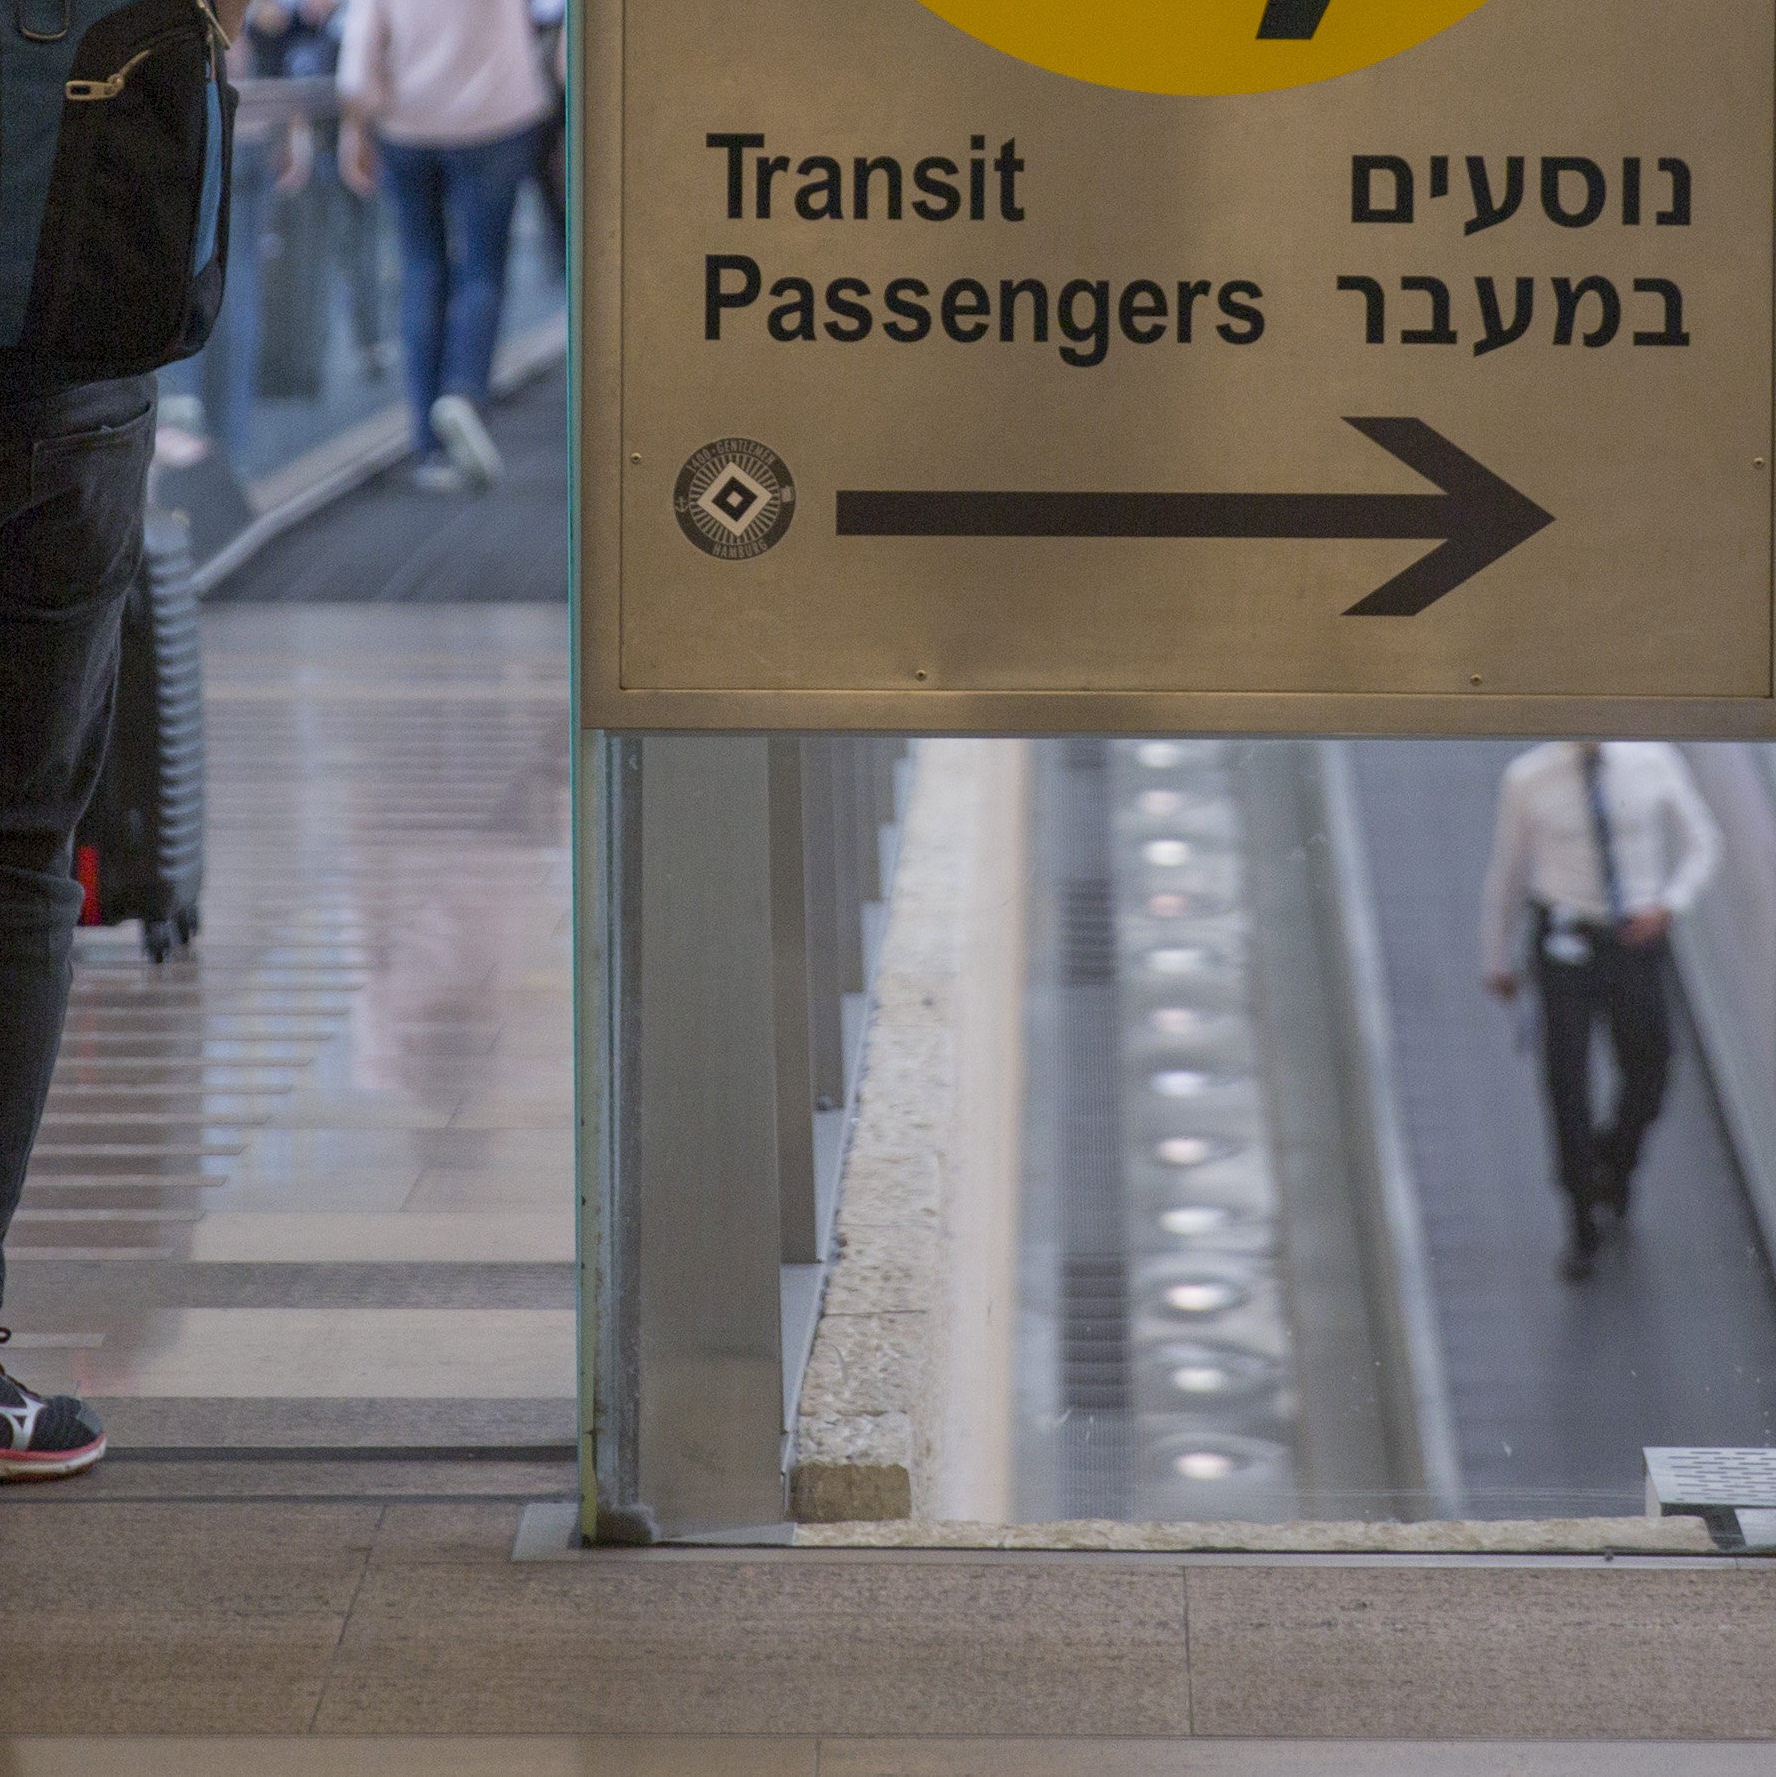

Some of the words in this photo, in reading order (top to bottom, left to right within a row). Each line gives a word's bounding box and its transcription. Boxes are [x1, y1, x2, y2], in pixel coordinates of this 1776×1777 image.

[705, 132, 1026, 223] Transit
[1351, 154, 1692, 237] נוסעים
[704, 254, 1266, 369] Passengers
[1336, 274, 1691, 358] במעבר
[715, 439, 778, 465] GENTLEMEN
[711, 539, 768, 558] HAMBURG
